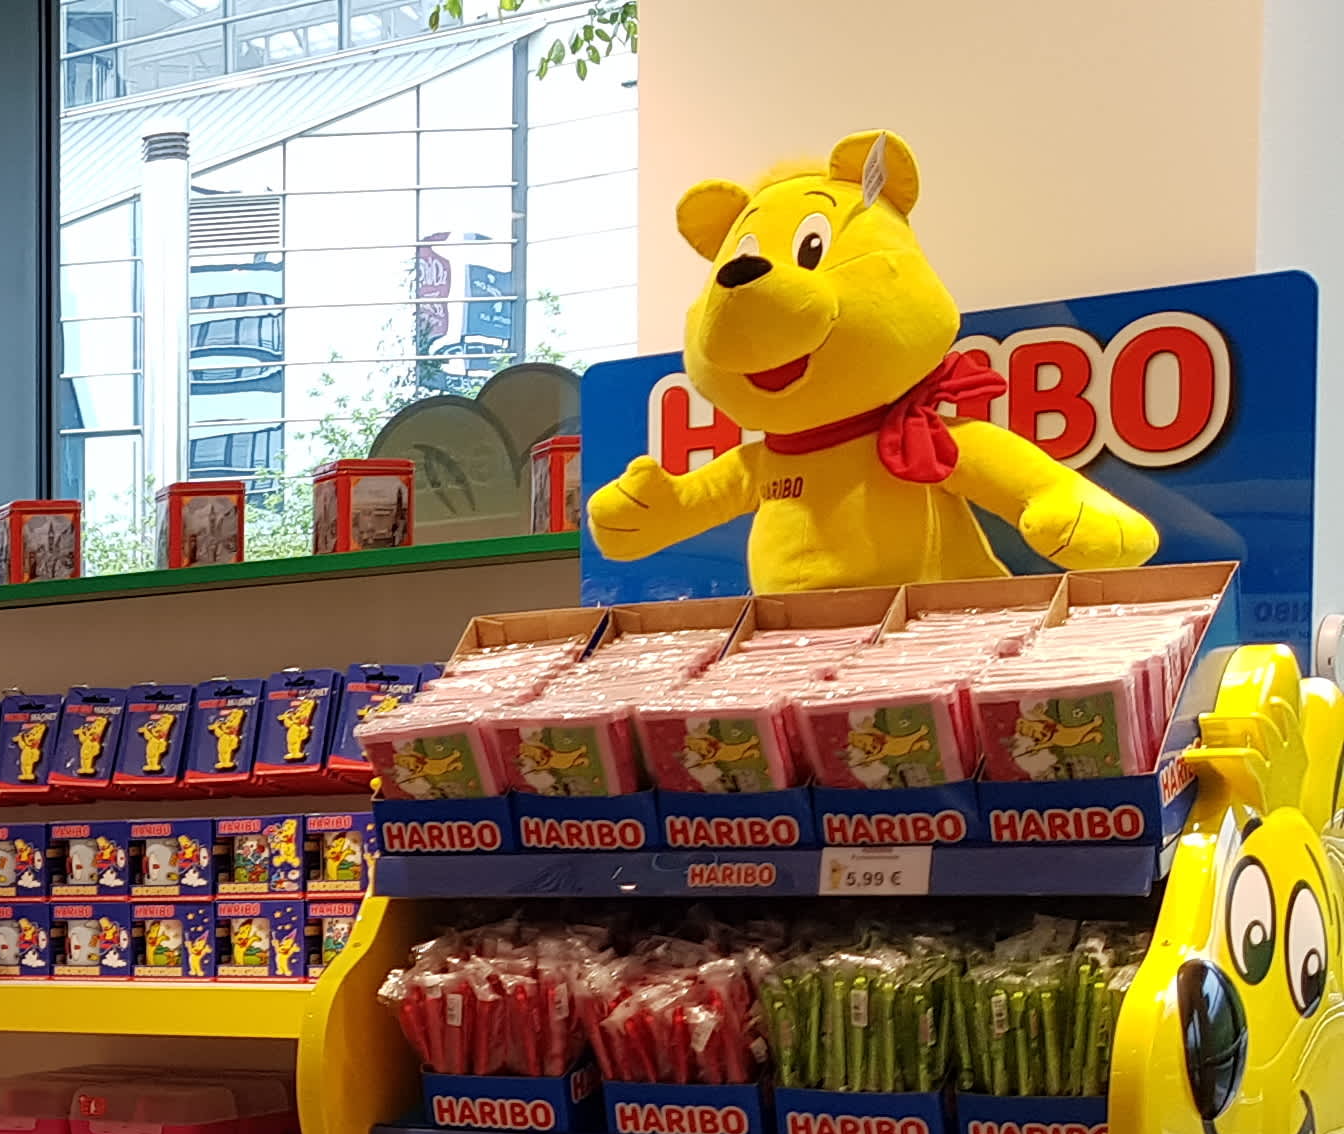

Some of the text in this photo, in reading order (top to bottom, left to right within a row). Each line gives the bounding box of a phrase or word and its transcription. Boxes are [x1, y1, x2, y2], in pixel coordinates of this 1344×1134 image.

[218, 820, 262, 833] HARIBO
[307, 816, 353, 830] HARIBO
[383, 819, 502, 853] HARIBO
[520, 816, 646, 851] HARIBO
[665, 815, 799, 847] HARIBO
[823, 810, 966, 845] HARIBO
[989, 802, 1145, 844] HARIBO
[688, 863, 776, 888] HARIBO
[890, 870, 903, 887] €
[218, 903, 261, 916] HARIBO
[433, 1095, 555, 1131] HARIBO
